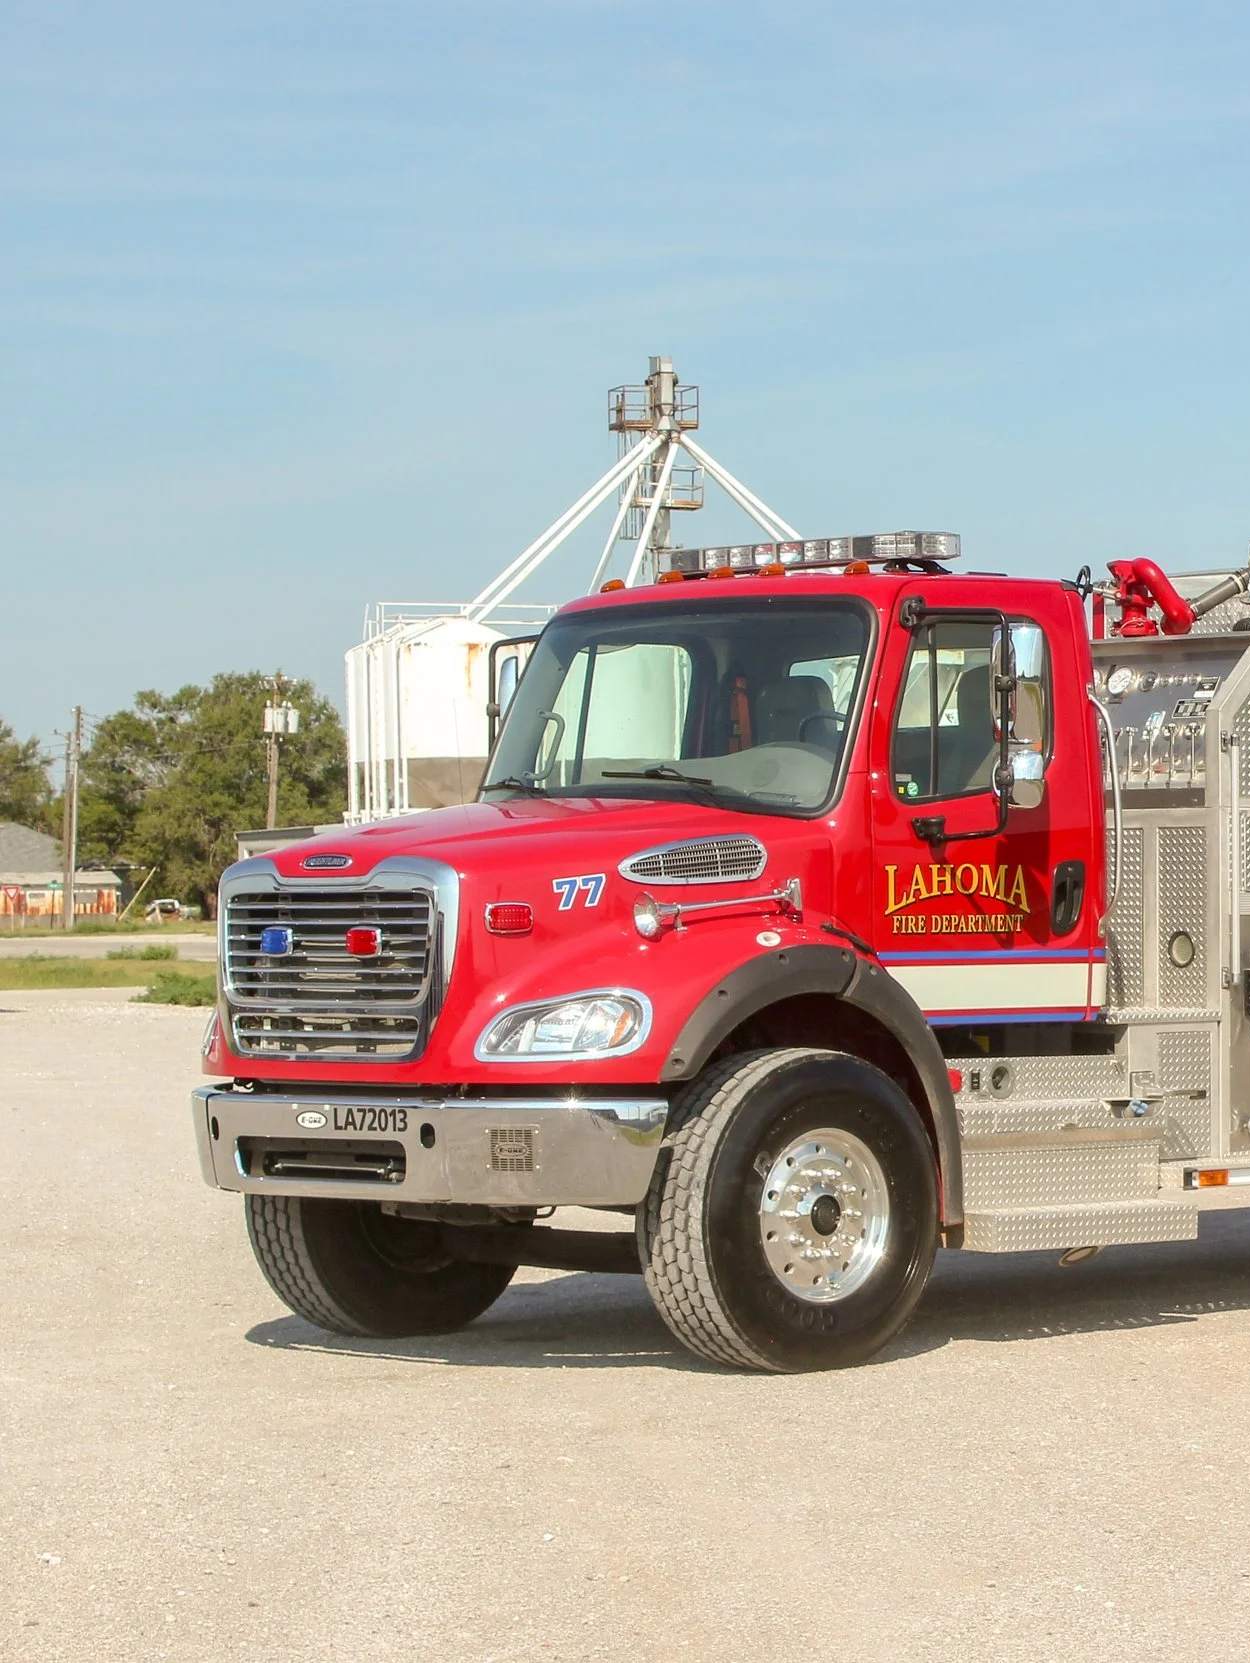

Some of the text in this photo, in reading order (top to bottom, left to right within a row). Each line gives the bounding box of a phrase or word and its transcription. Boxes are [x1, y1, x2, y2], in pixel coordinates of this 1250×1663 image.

[552, 873, 606, 911] 77
[885, 863, 1031, 915] LAHOMA
[892, 914, 1024, 934] FIRE DEPARTMENT
[333, 1107, 408, 1132] LA72013
